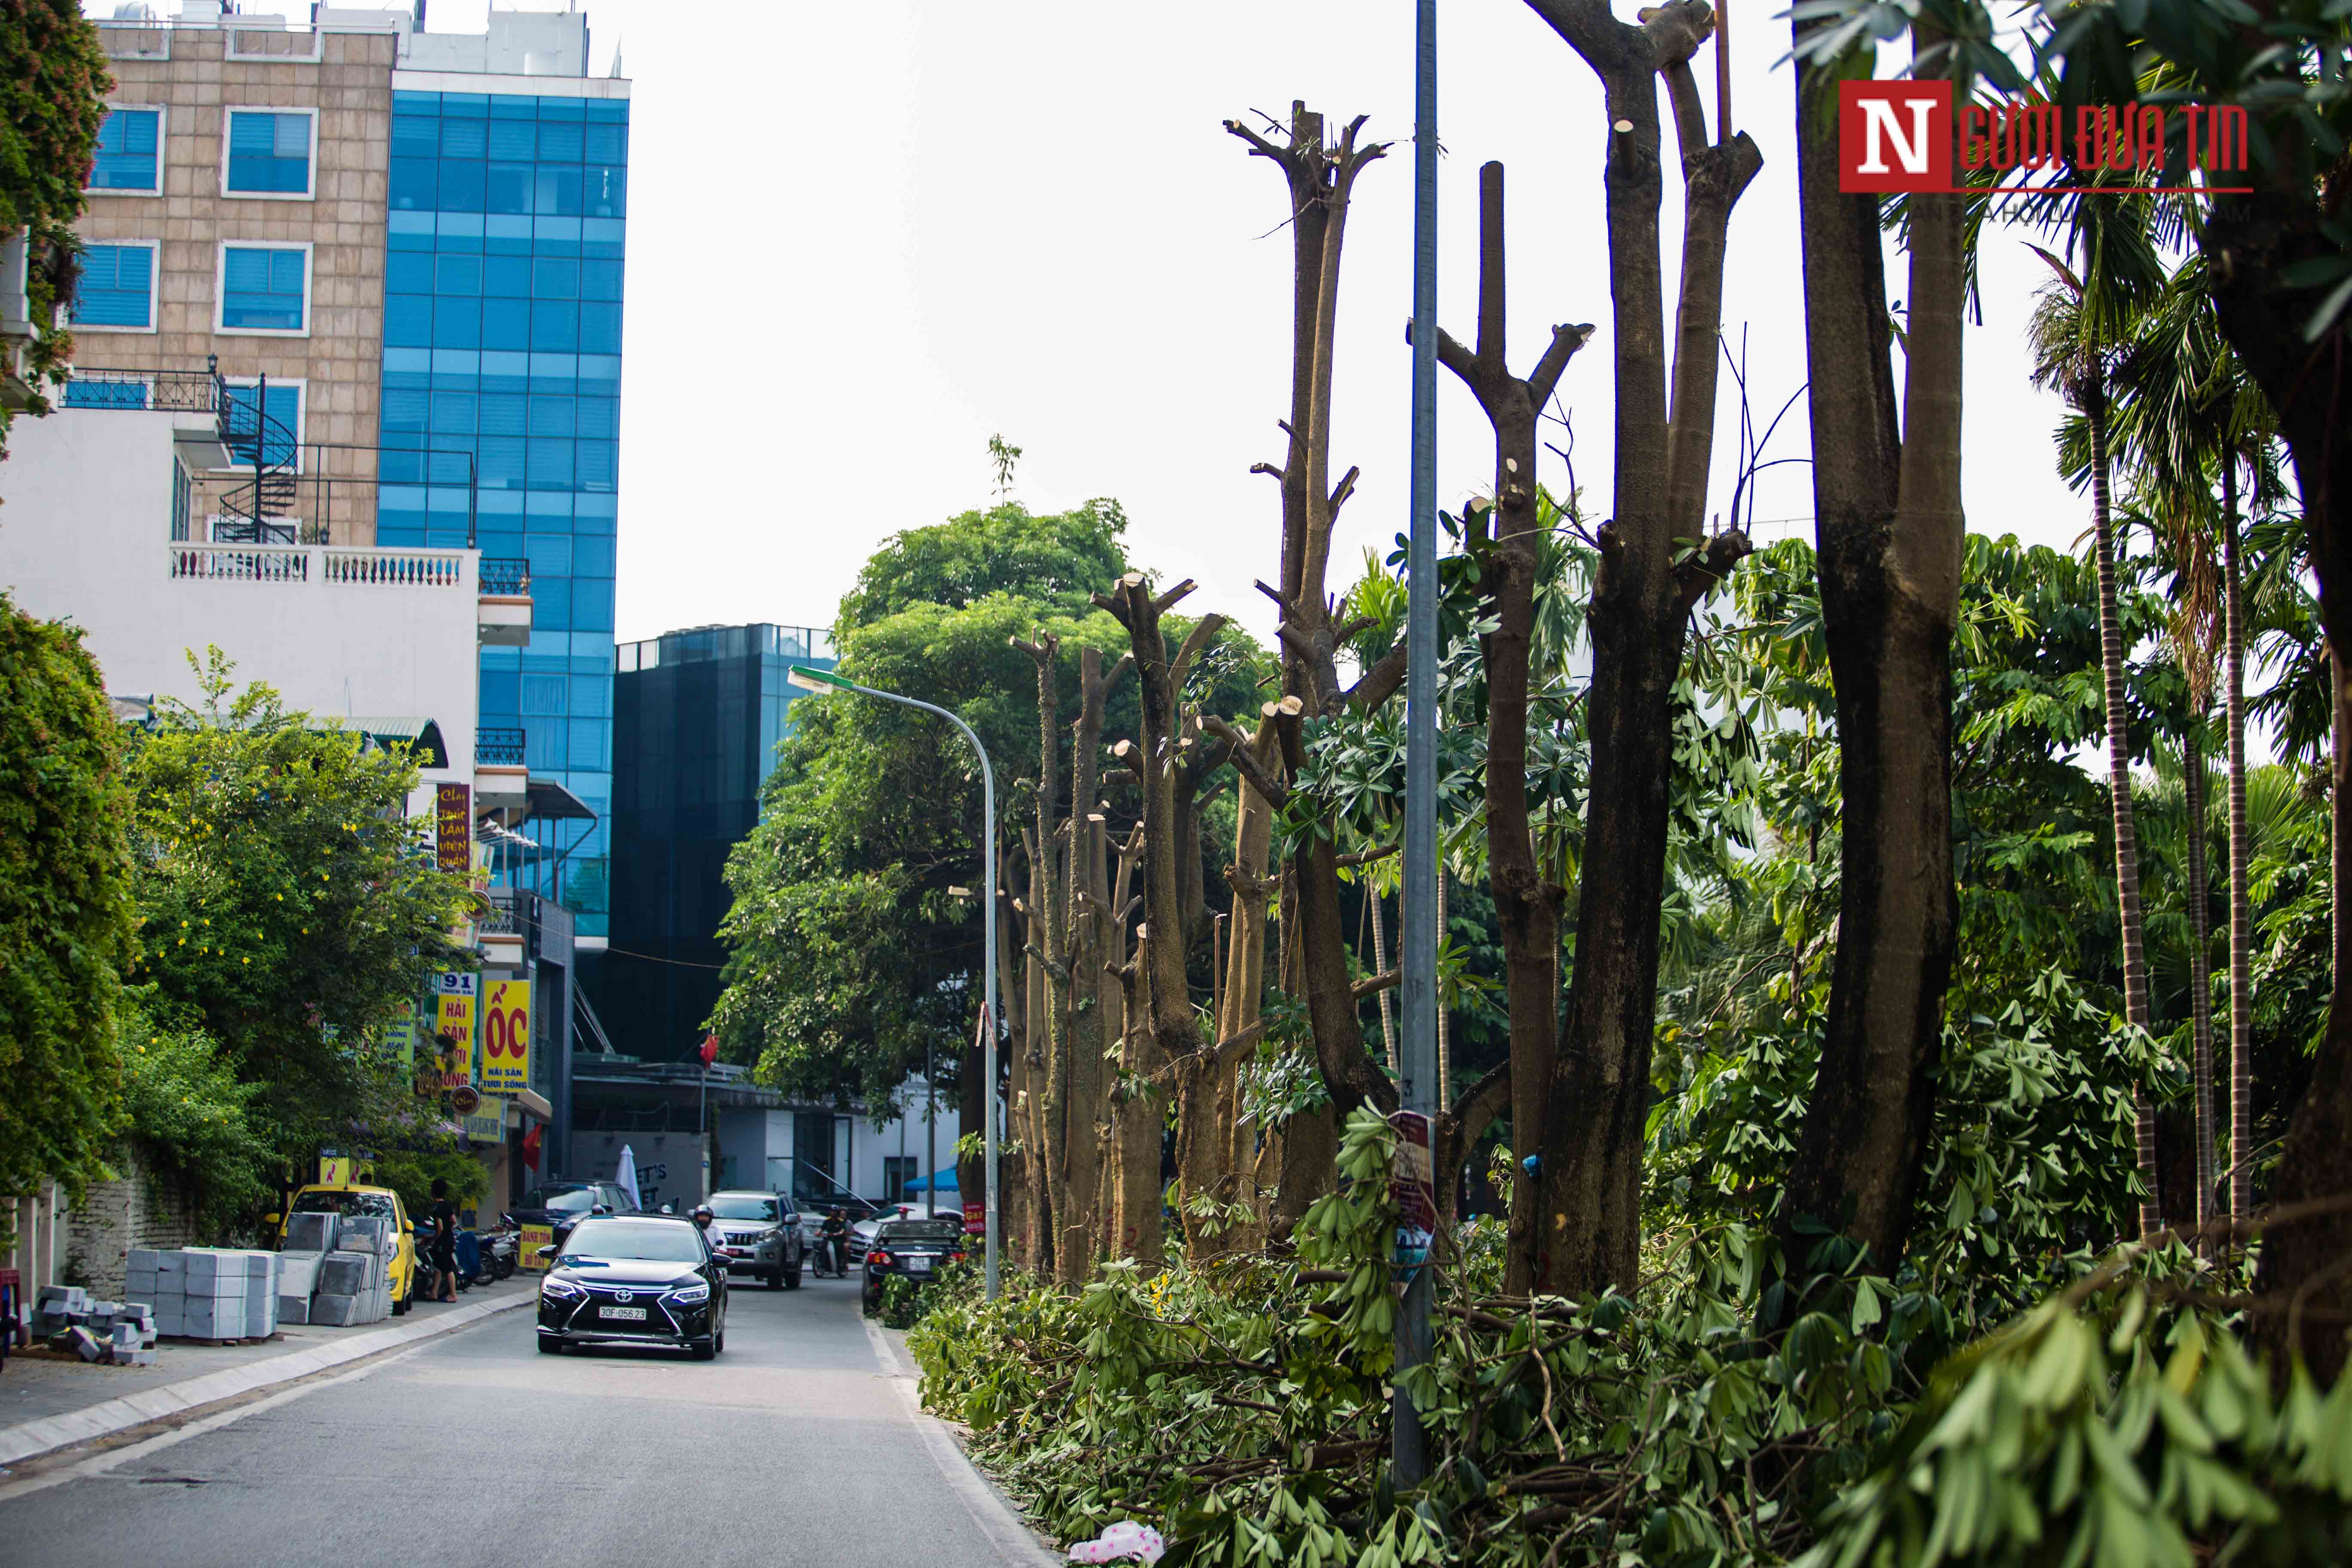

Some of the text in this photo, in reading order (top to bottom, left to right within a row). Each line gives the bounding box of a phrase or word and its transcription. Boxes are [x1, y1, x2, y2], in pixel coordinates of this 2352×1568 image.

[444, 974, 471, 988] 91
[446, 998, 466, 1018] HẢI
[443, 1021, 467, 1041] SẢN
[486, 983, 527, 1059] ỐC
[488, 1066, 523, 1077] HẢI SẢN
[637, 1164, 667, 1185] ET'S
[601, 1308, 645, 1318] 30F-056.23
